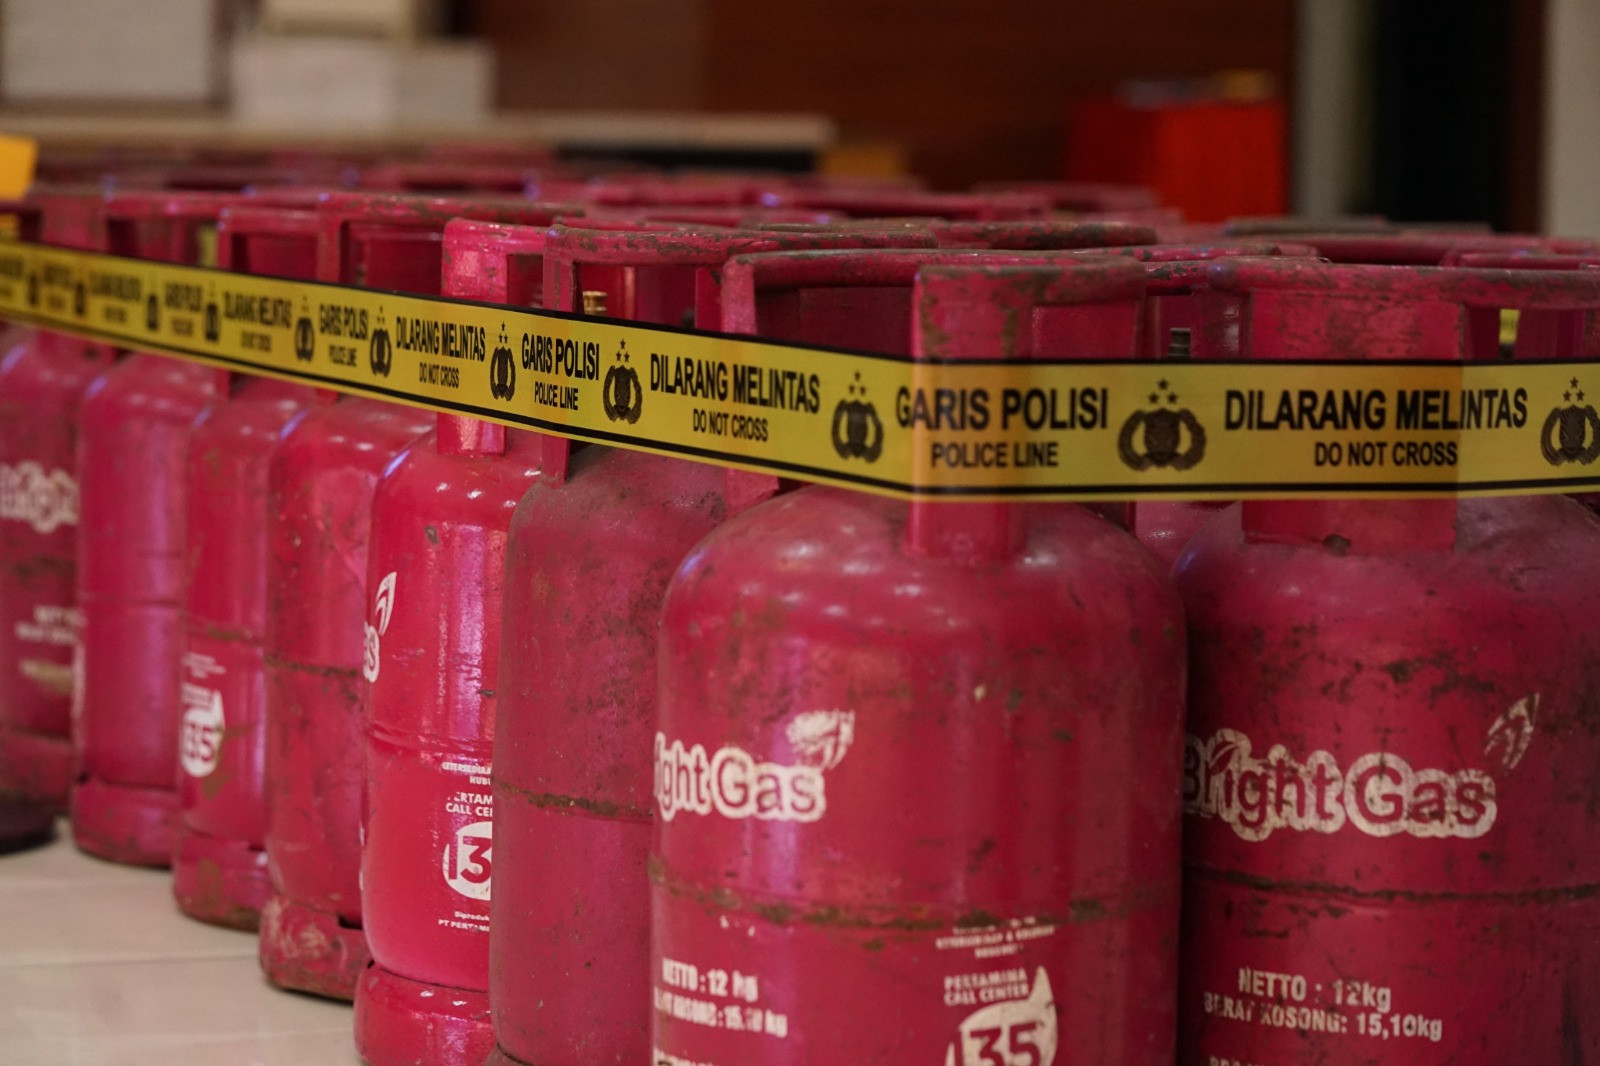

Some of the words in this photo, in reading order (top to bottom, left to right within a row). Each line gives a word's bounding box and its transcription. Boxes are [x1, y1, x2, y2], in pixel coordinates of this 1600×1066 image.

[344, 306, 369, 340] POLISI
[396, 316, 440, 355] DILARANG
[441, 322, 486, 362] MELINTAS
[521, 332, 553, 374] GARIS
[555, 337, 600, 381] POLISI
[419, 362, 427, 383] DO
[428, 365, 439, 386] NOT
[440, 367, 460, 389] CROSS
[650, 352, 728, 402] DILARANG
[732, 363, 821, 415] MELINTAS
[534, 381, 558, 407] POLICE
[559, 385, 579, 410] LINE
[896, 386, 991, 431] GARIS
[1001, 386, 1108, 431] POLISI
[1224, 389, 1387, 431] DILARANG
[1395, 387, 1528, 431] MELINTAS
[693, 408, 707, 432] DO
[709, 411, 730, 437] NOT
[731, 414, 769, 442] CROSS
[930, 441, 1009, 468] POLICE
[1012, 440, 1059, 467] LINE
[1314, 441, 1342, 467] DO
[1347, 441, 1388, 467] NOT
[1392, 441, 1459, 467] CROSS
[445, 802, 473, 815] CALL
[438, 918, 450, 927] PT
[1238, 967, 1307, 1002] NETTO
[1333, 979, 1392, 1014] 12kg
[1356, 1013, 1443, 1043] 15,10kg
